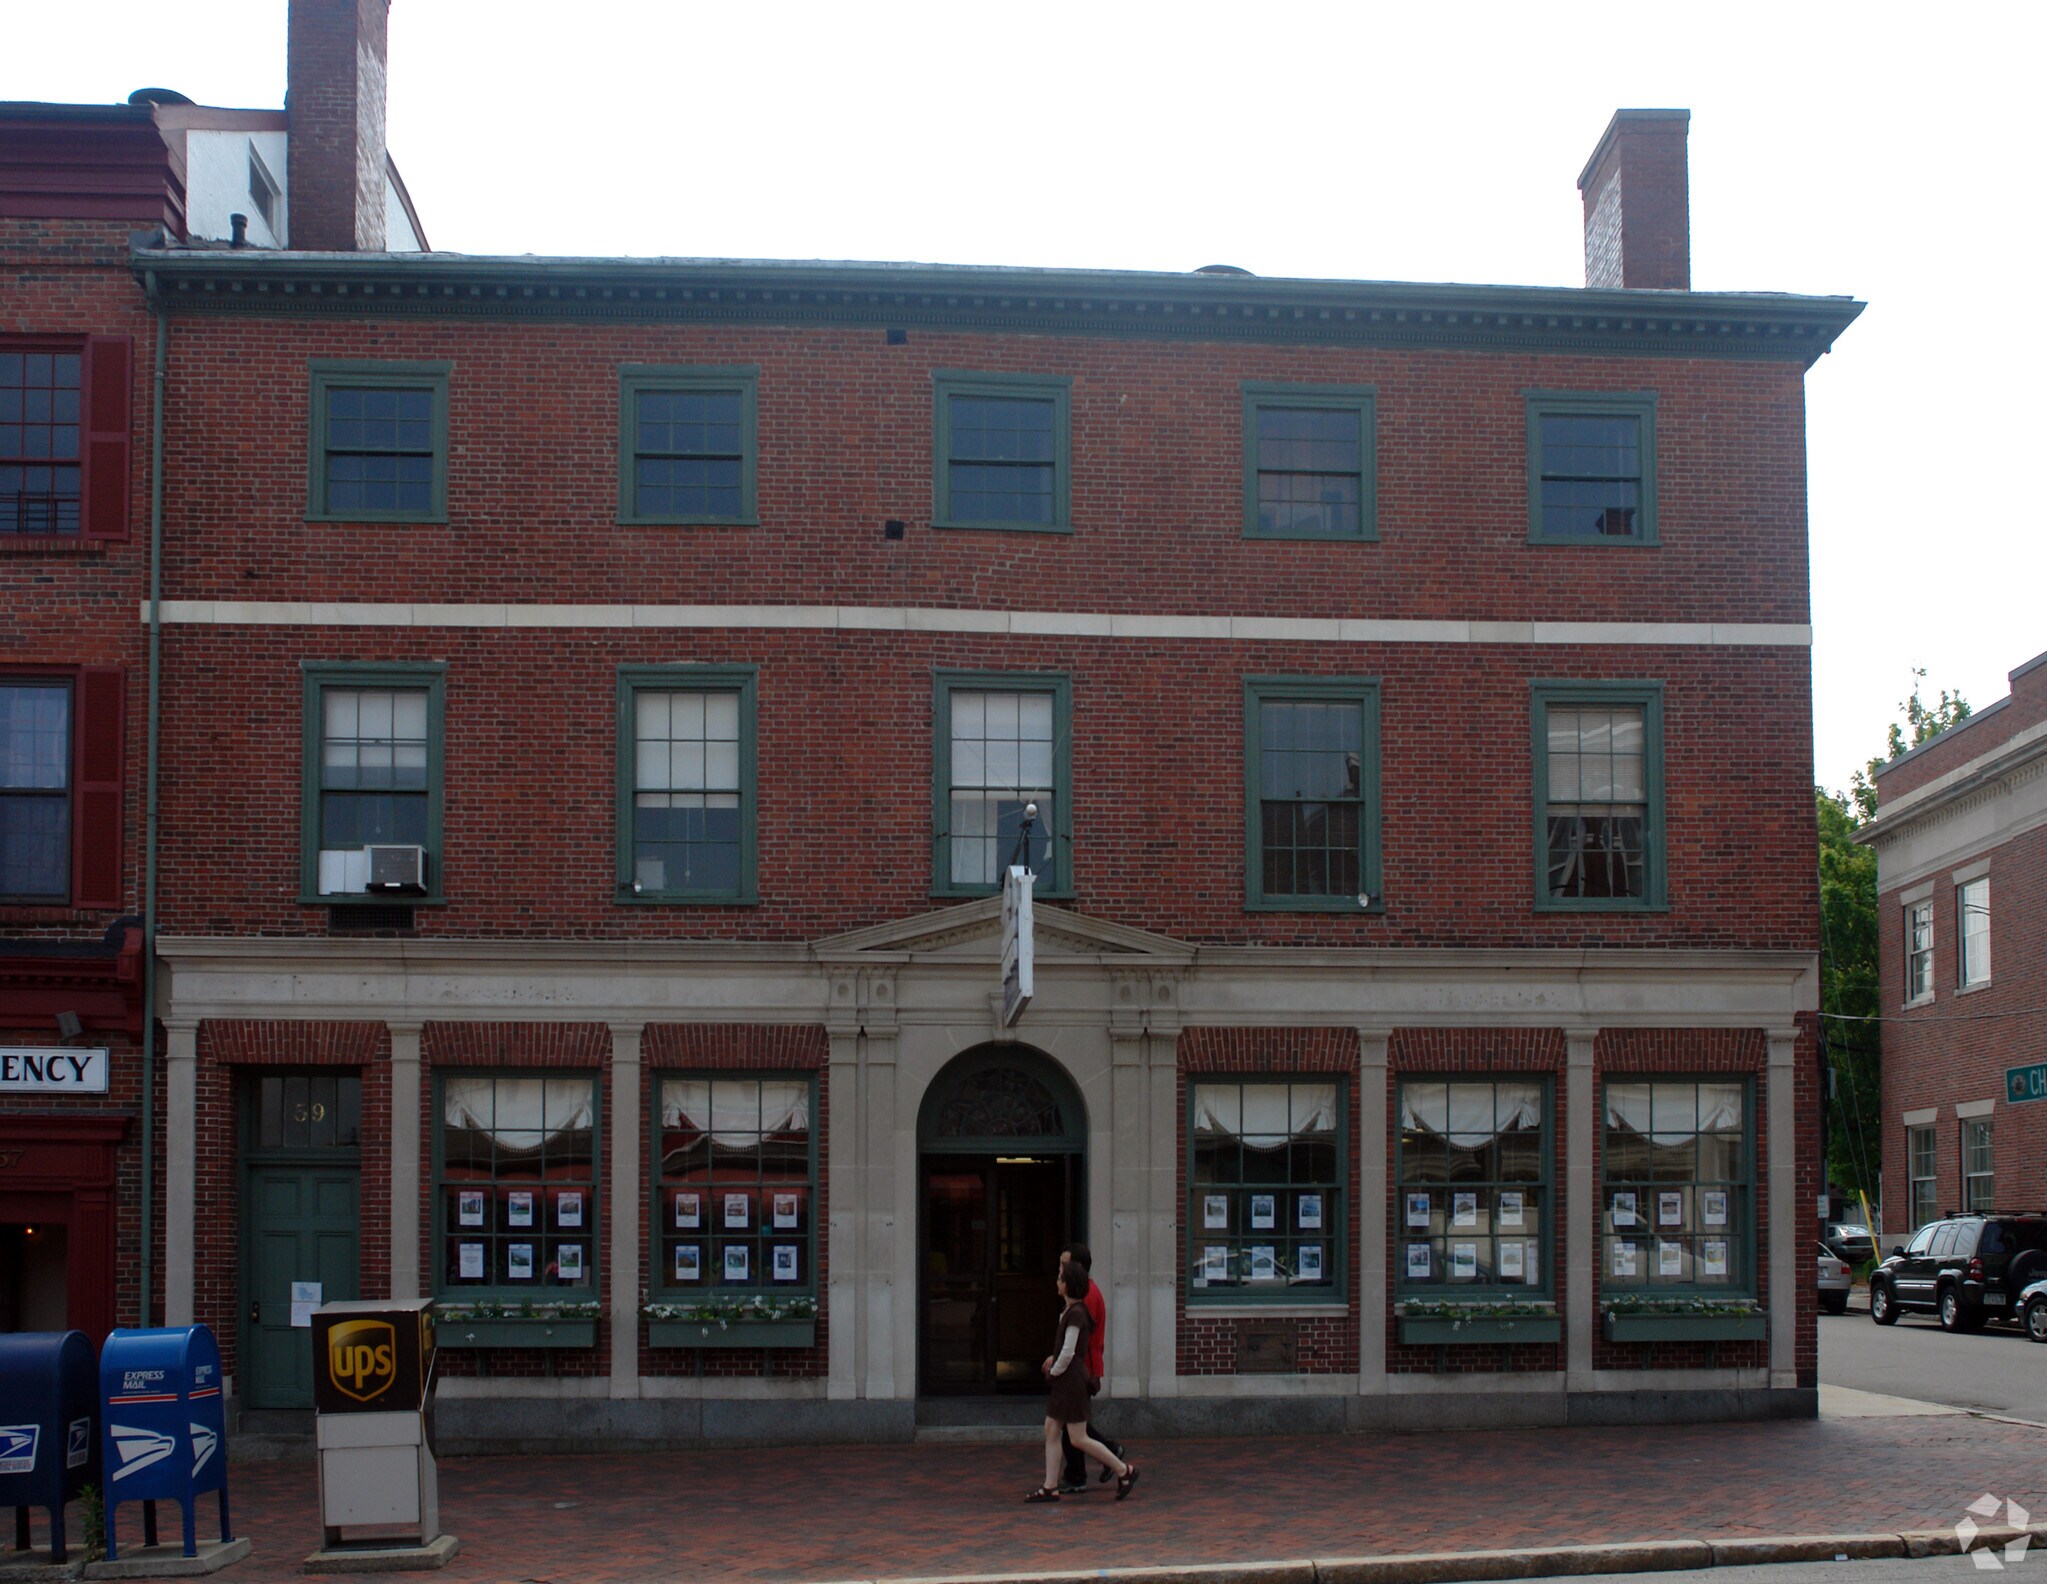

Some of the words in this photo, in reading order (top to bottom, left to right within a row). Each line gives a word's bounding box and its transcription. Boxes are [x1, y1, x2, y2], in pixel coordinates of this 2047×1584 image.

[2, 1056, 92, 1081] ENCY
[2030, 1068, 2047, 1096] CH
[294, 1103, 325, 1123] 59
[124, 1370, 165, 1380] EXPRESS
[334, 1344, 392, 1389] ups
[122, 1380, 146, 1390] MAIL
